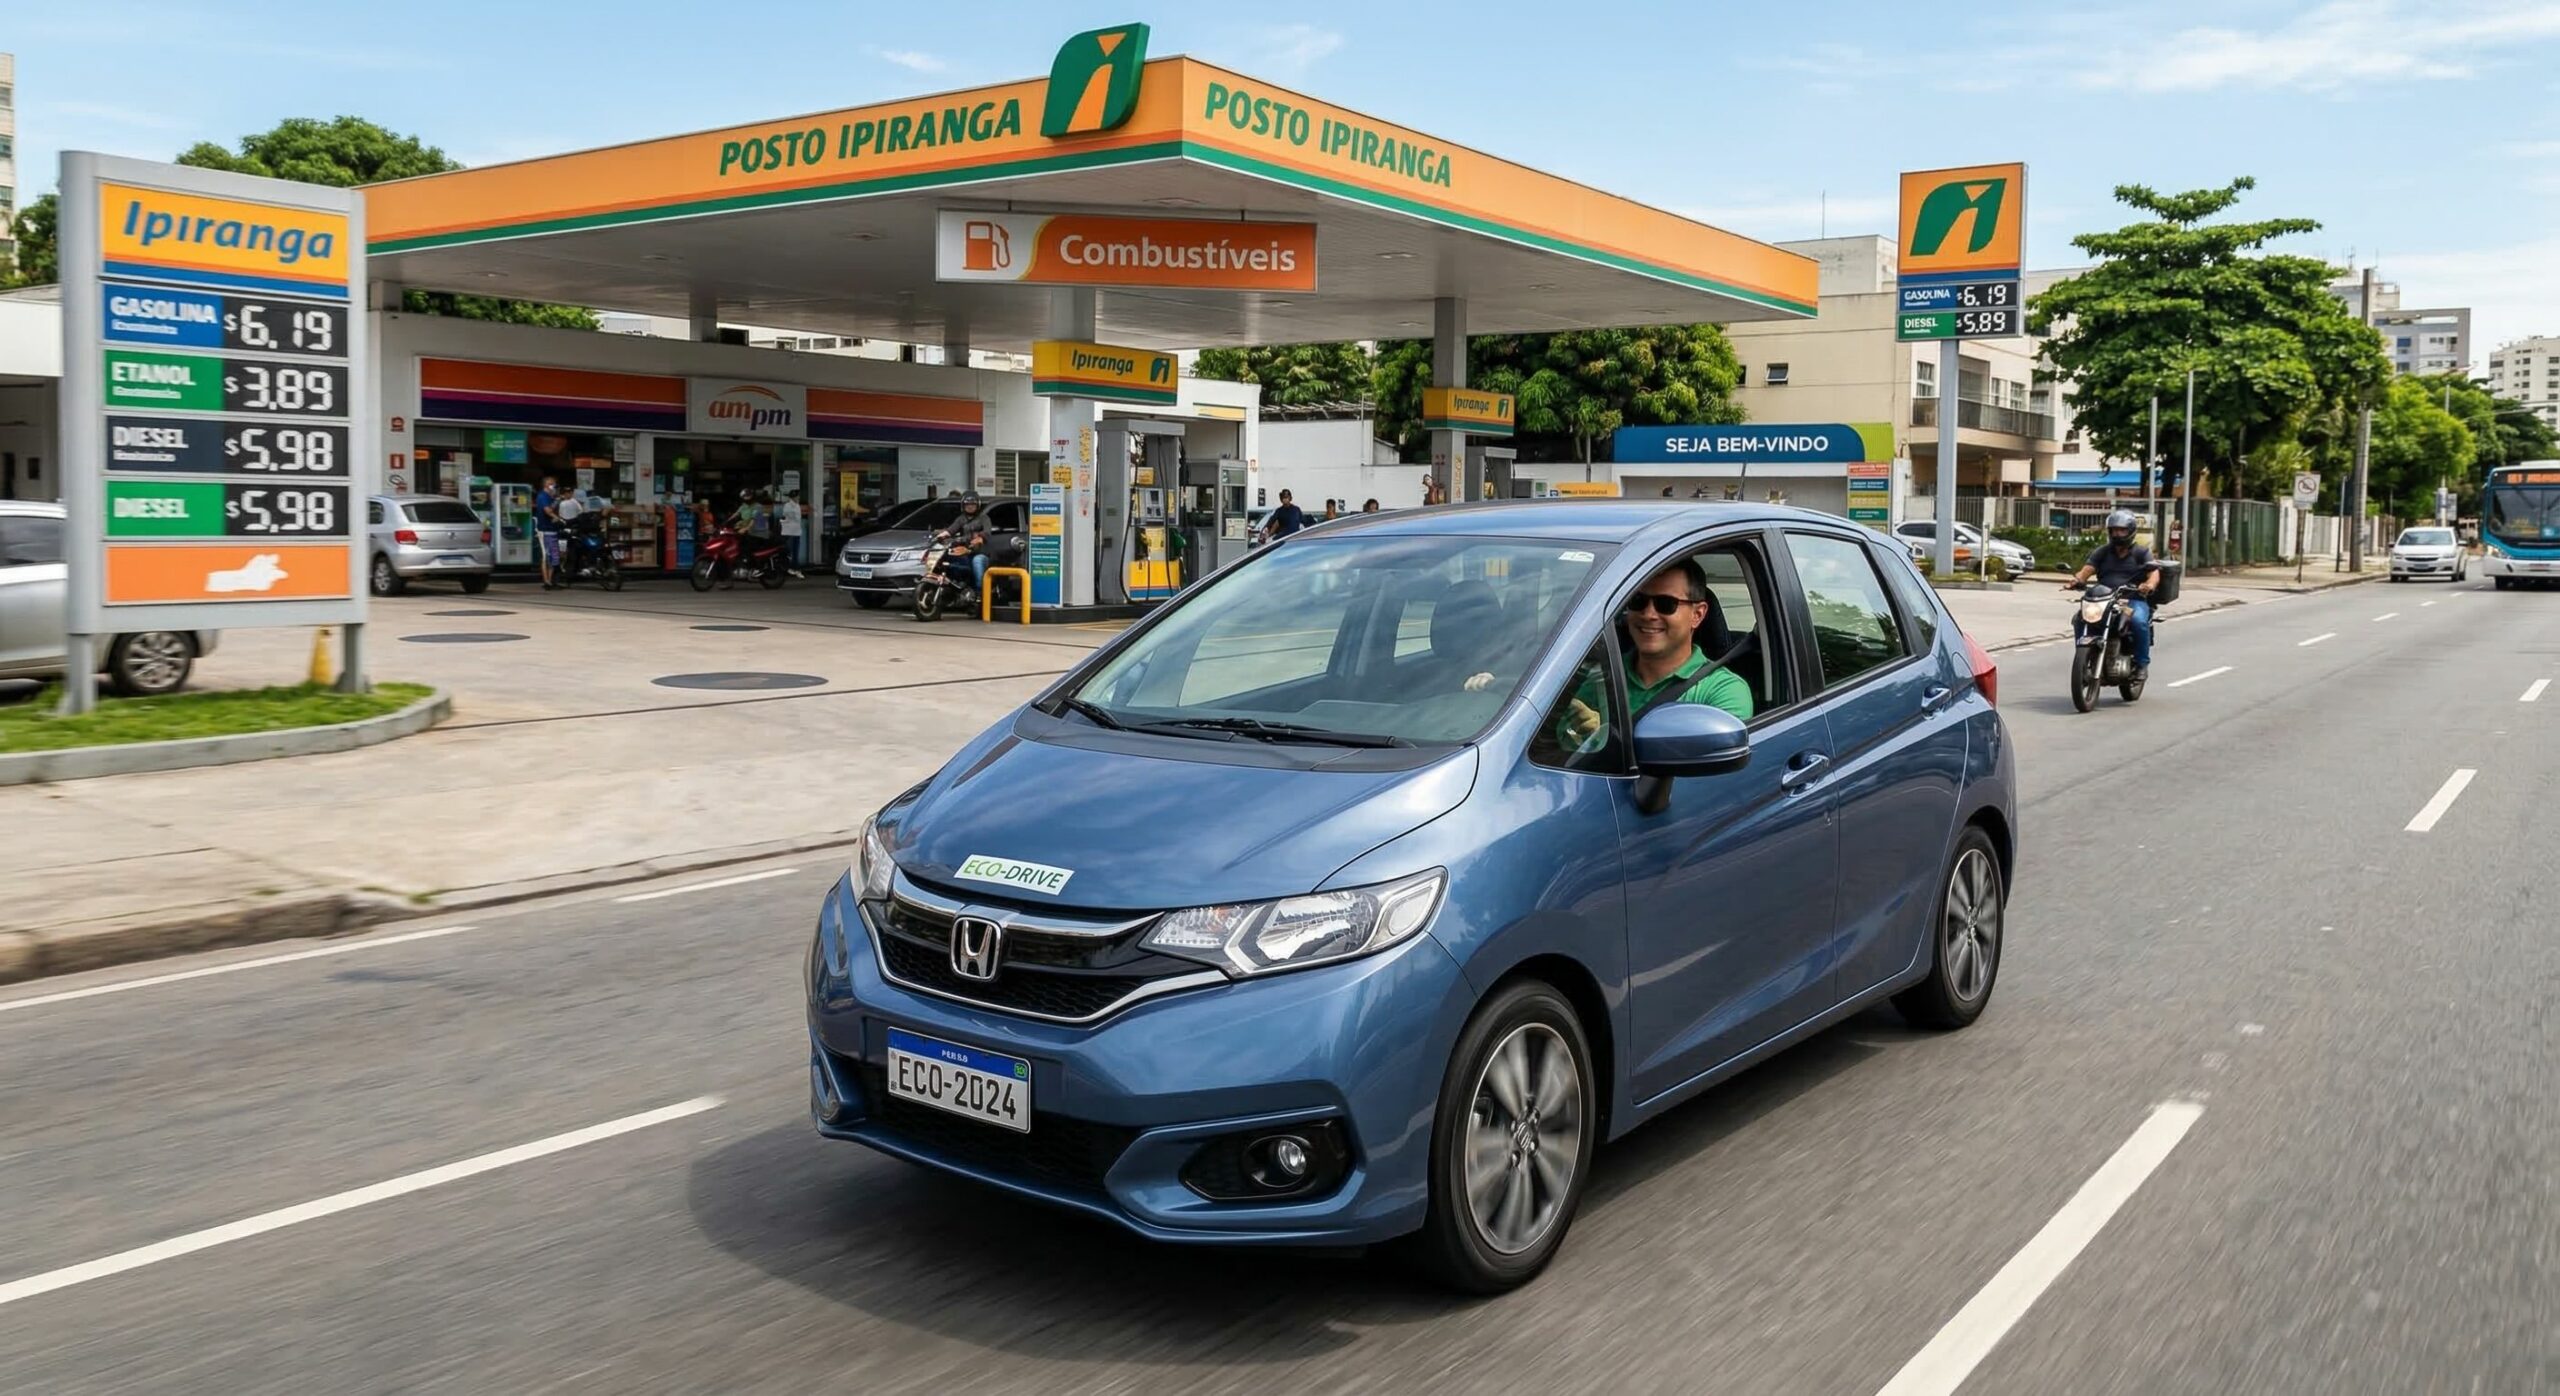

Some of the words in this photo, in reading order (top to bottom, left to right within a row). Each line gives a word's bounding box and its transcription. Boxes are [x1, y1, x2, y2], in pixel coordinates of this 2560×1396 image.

[719, 128, 826, 176] POSTO
[838, 98, 1021, 159] IPIRANGA
[1205, 81, 1310, 146] POSTO
[1319, 118, 1451, 188] IPIRANGA
[123, 200, 334, 264] Ipiranga
[1060, 234, 1296, 272] Combustíveis
[110, 296, 218, 324] GASOLINA
[1904, 317, 1939, 329] DIESEL
[1071, 349, 1134, 376] Ipiranga
[111, 361, 197, 386] ETANOL
[224, 366, 333, 411] $3.89
[1453, 394, 1490, 415] Ipiranga
[708, 400, 792, 431] ampm
[112, 425, 190, 449] DIESEL
[224, 428, 333, 472] $5.98
[1666, 437, 1712, 453] SEJA
[1717, 435, 1829, 453] BEM-VINDO
[113, 497, 191, 519] DIESEL
[225, 490, 334, 534] $5.98
[963, 860, 1064, 889] ECO-DRIVE
[899, 1055, 1016, 1121] ECO-2024
